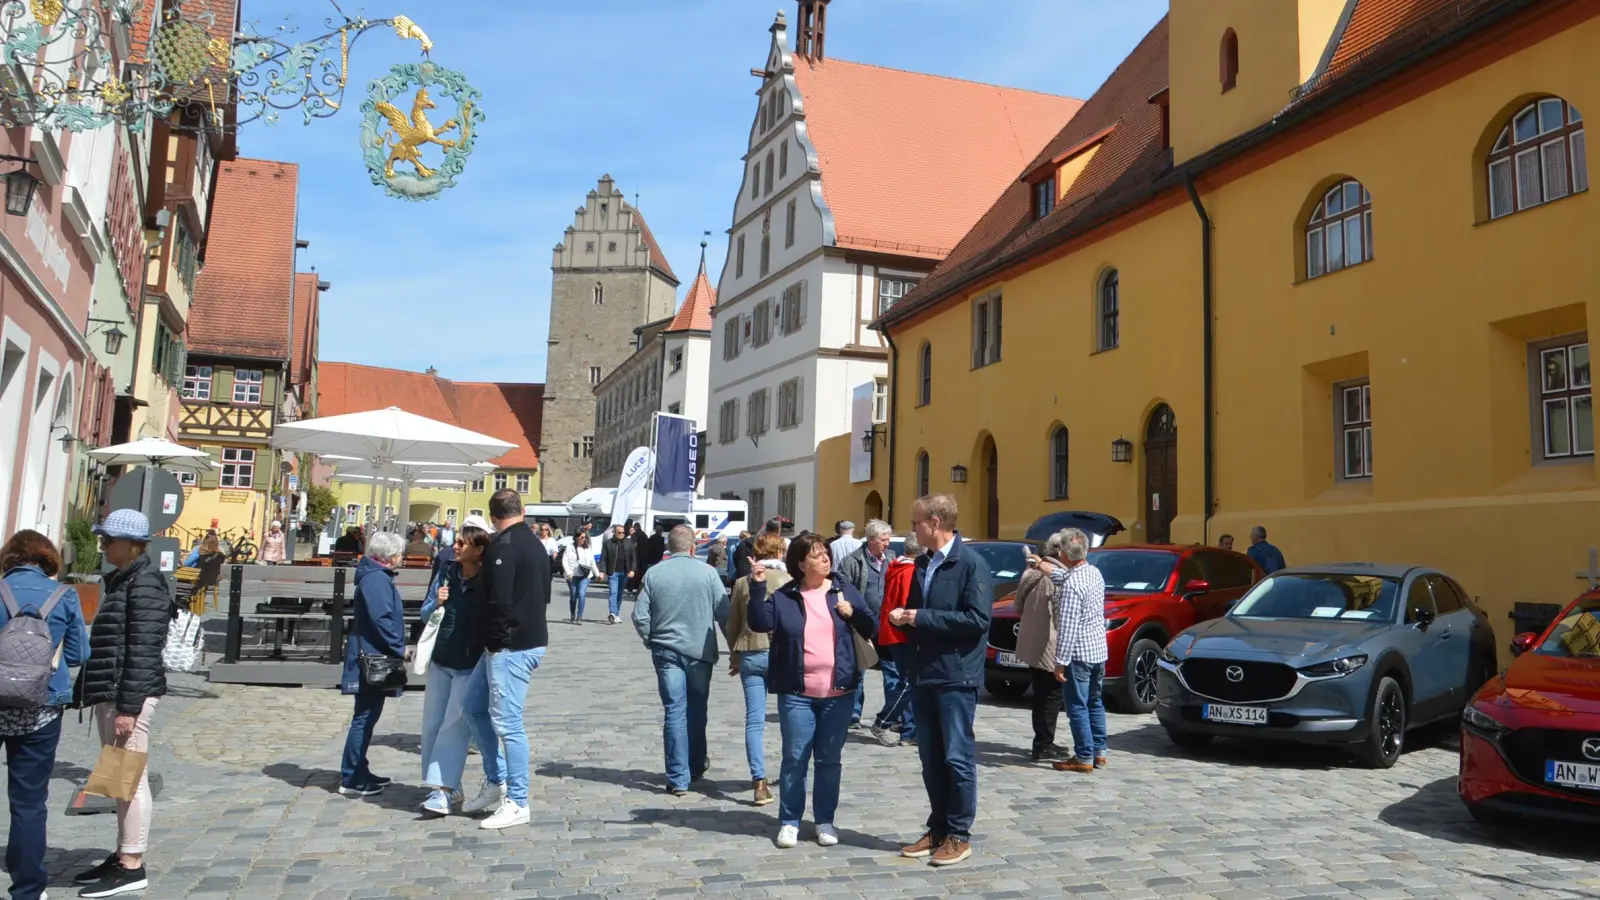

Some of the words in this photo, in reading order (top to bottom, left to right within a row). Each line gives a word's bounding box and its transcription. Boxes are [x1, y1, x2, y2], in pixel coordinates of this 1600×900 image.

[1209, 705, 1222, 718] AN
[1556, 763, 1577, 781] AN
[1588, 766, 1600, 784] W
